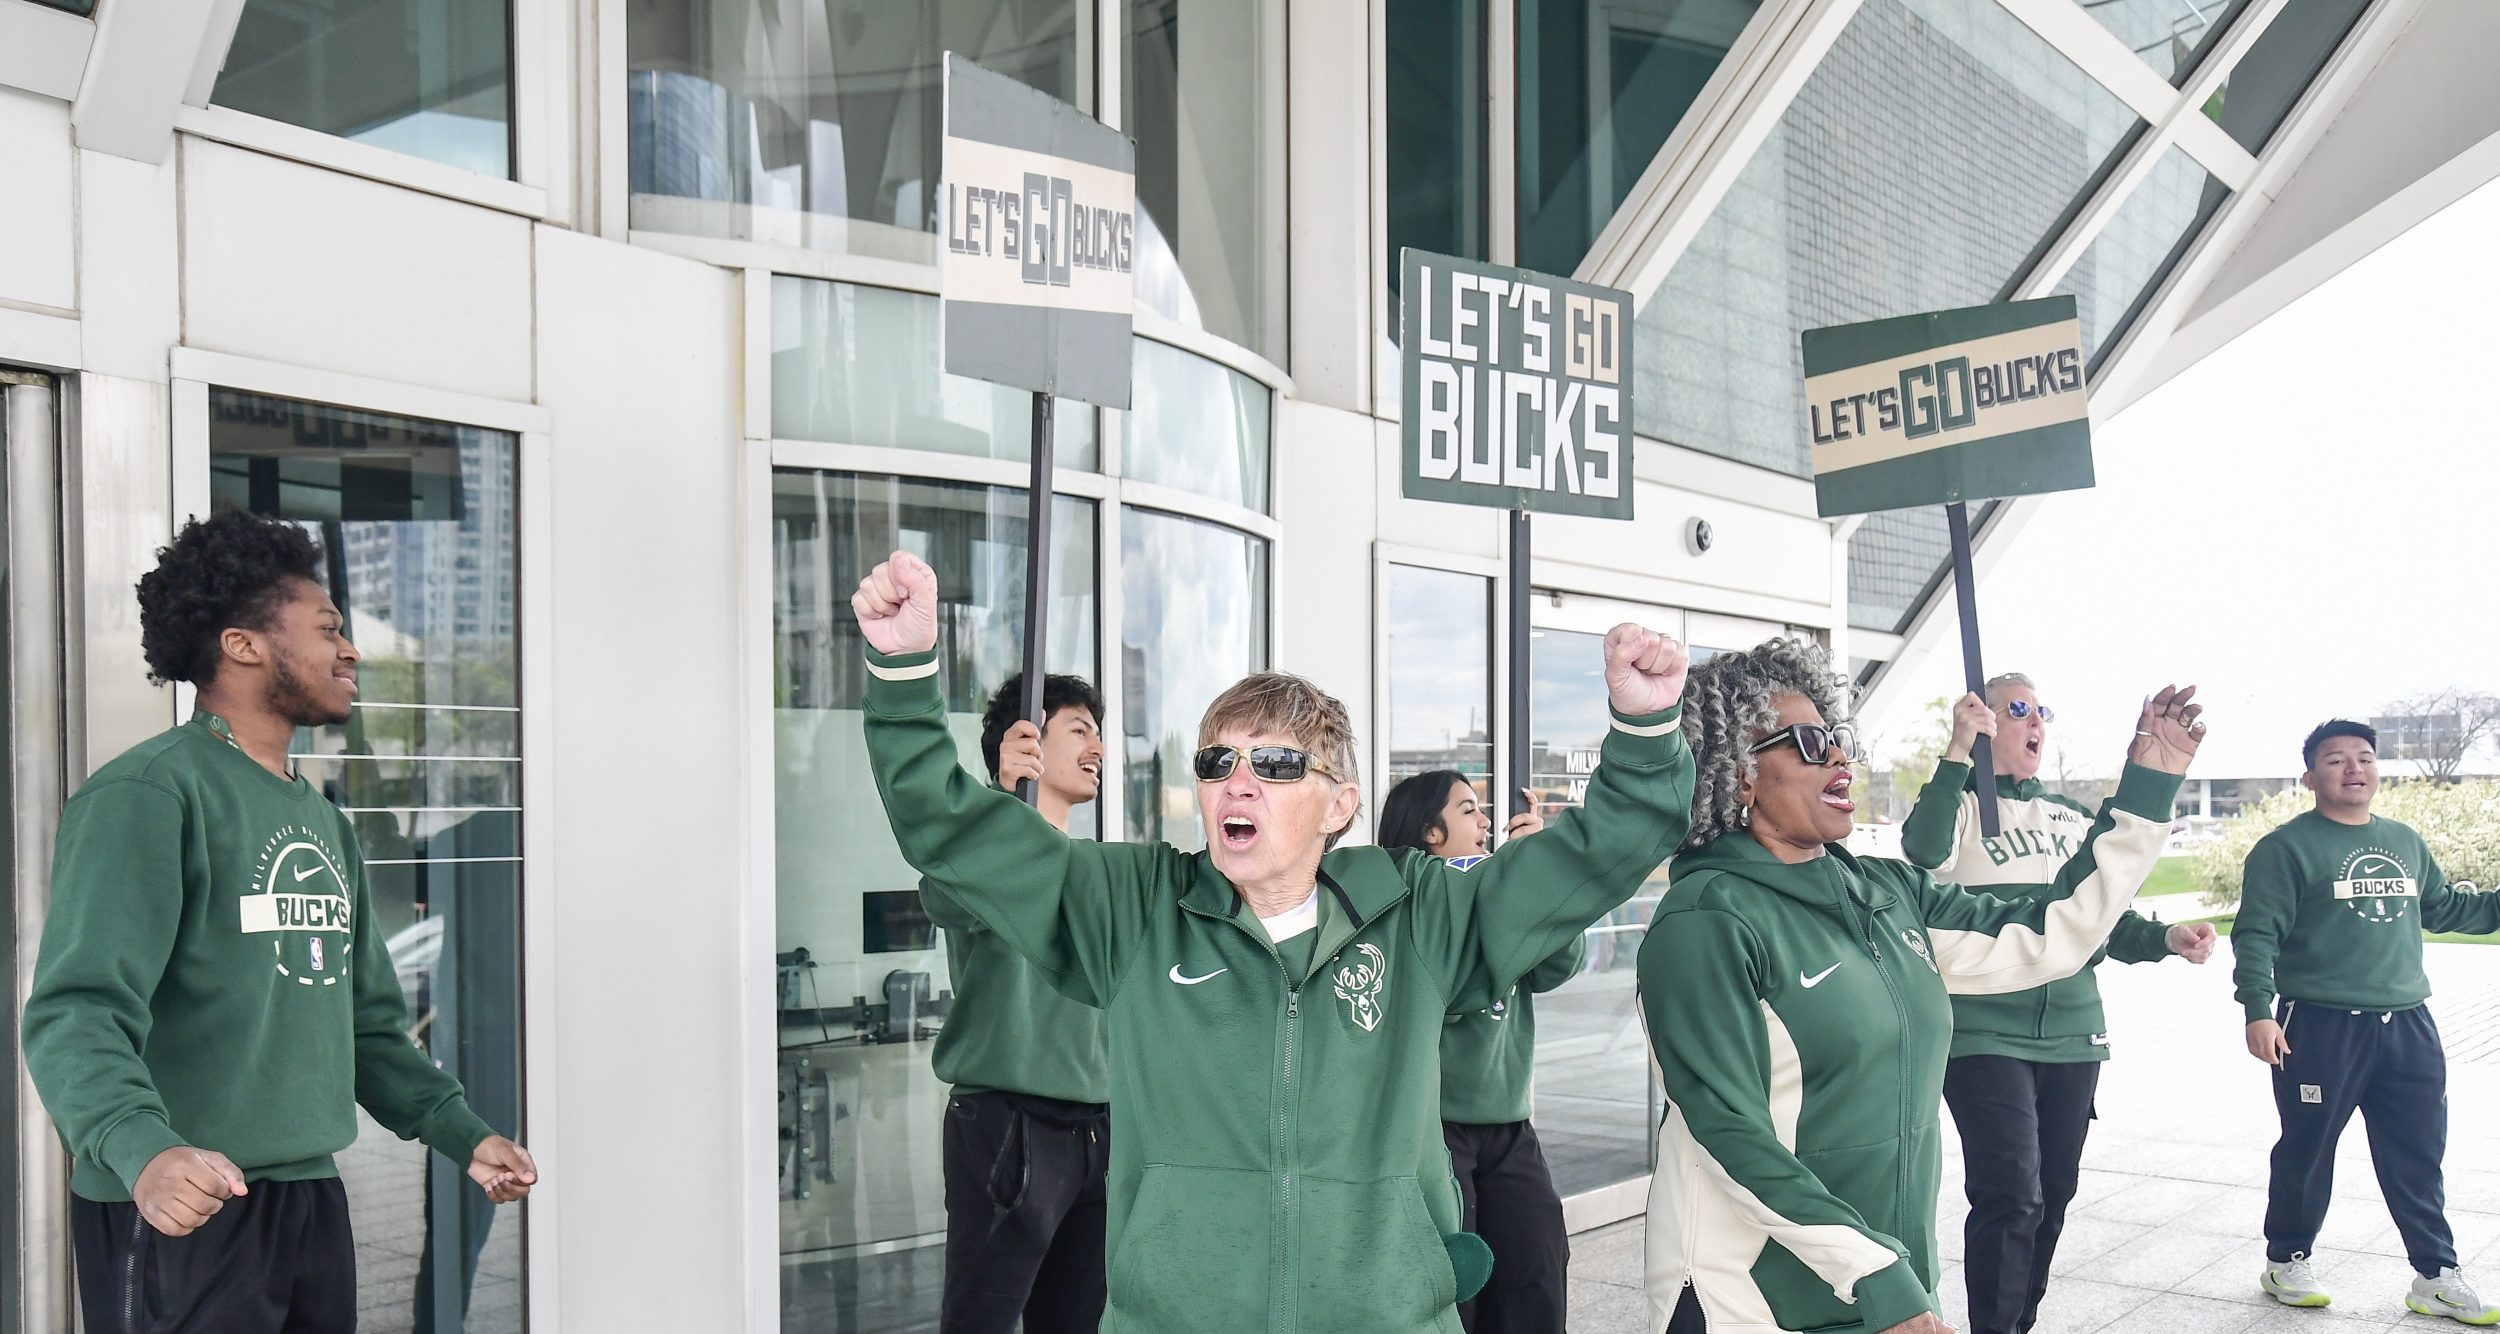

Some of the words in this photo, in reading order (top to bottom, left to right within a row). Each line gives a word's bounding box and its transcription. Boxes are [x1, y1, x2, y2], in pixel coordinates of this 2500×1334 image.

[949, 183, 1019, 259] LET'S
[1022, 171, 1073, 287] GO
[1073, 203, 1133, 274] BUCKS
[1420, 265, 1551, 373] LET'S
[1565, 293, 1620, 385] GO
[1419, 359, 1620, 499] BUCKS
[1810, 386, 1901, 445] LET'S
[1899, 356, 1976, 441] GO
[1973, 347, 2083, 410] BUCKS
[1567, 779, 1589, 801] AR
[1981, 827, 2084, 867] BUCK
[275, 897, 350, 928] BUCKS
[2352, 880, 2405, 896] BUCKS
